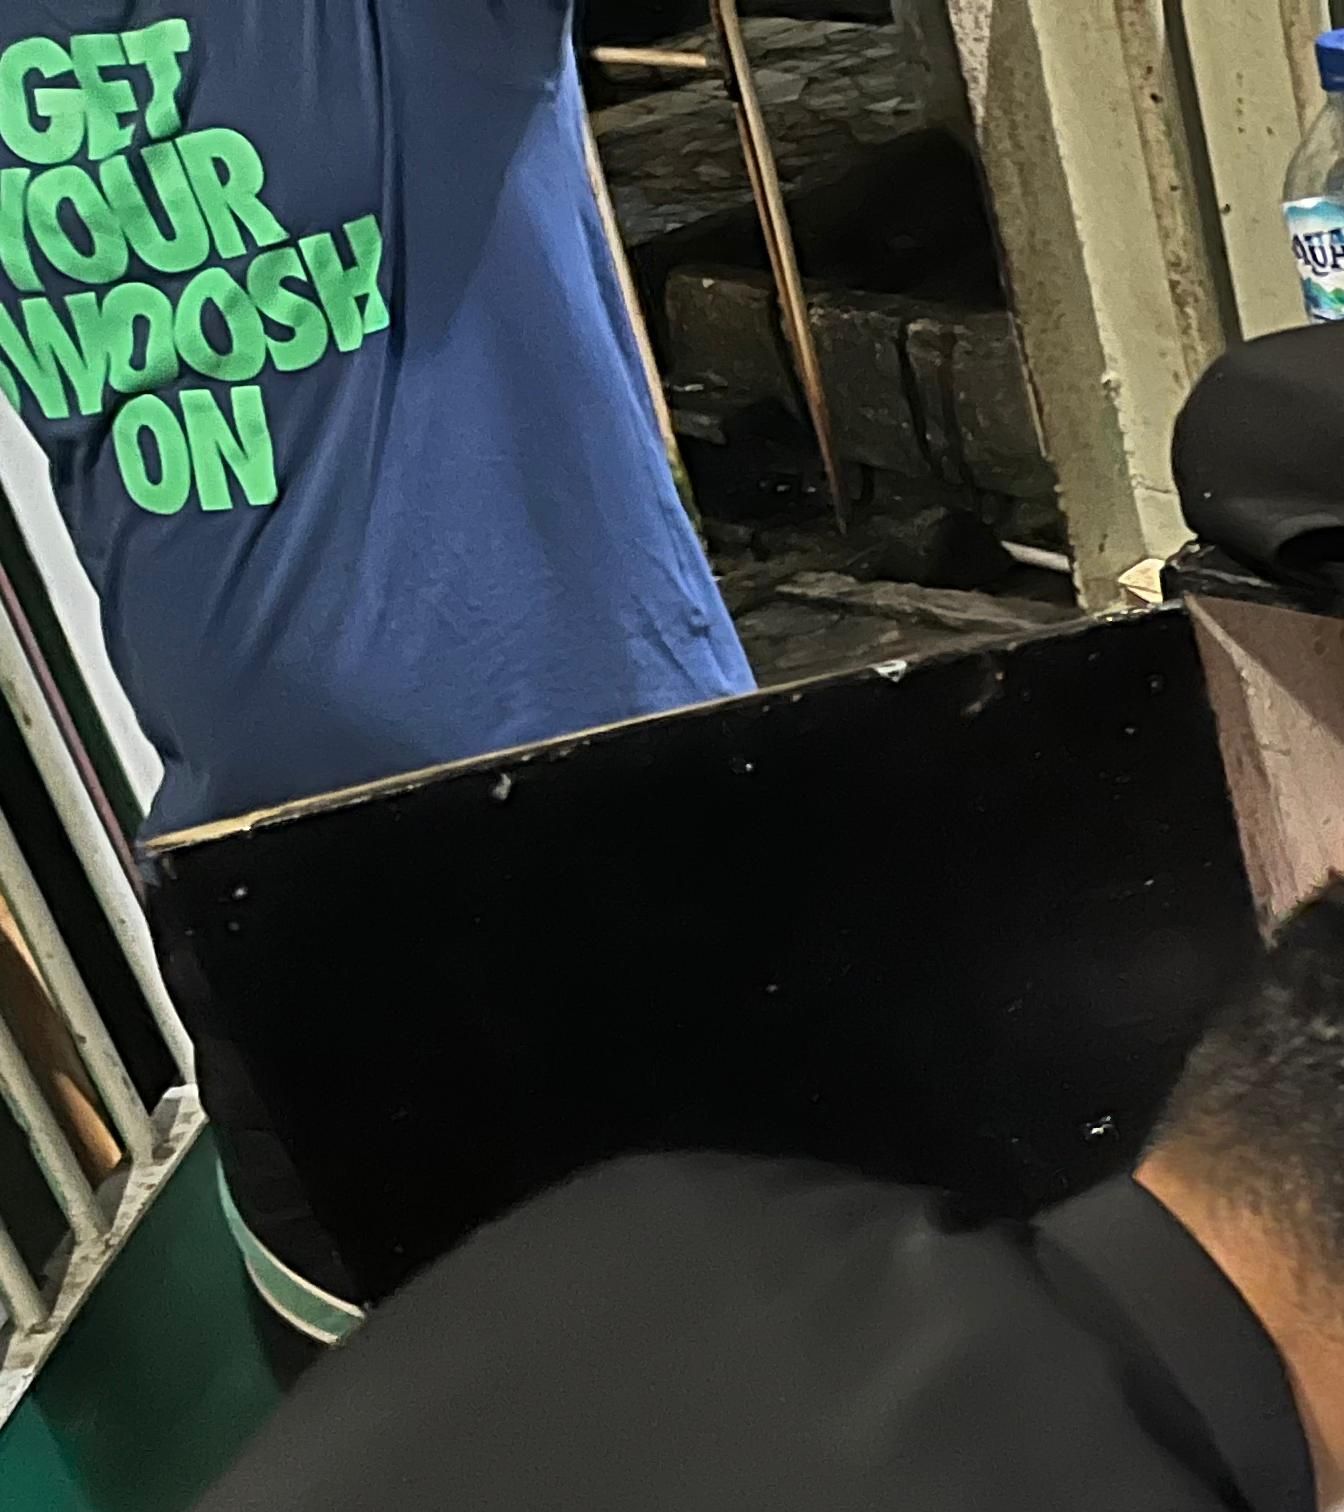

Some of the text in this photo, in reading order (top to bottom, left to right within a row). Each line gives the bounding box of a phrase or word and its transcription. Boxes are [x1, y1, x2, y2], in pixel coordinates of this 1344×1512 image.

[0, 18, 191, 165] GET
[0, 215, 390, 420] WOOSH
[112, 385, 278, 515] ON
